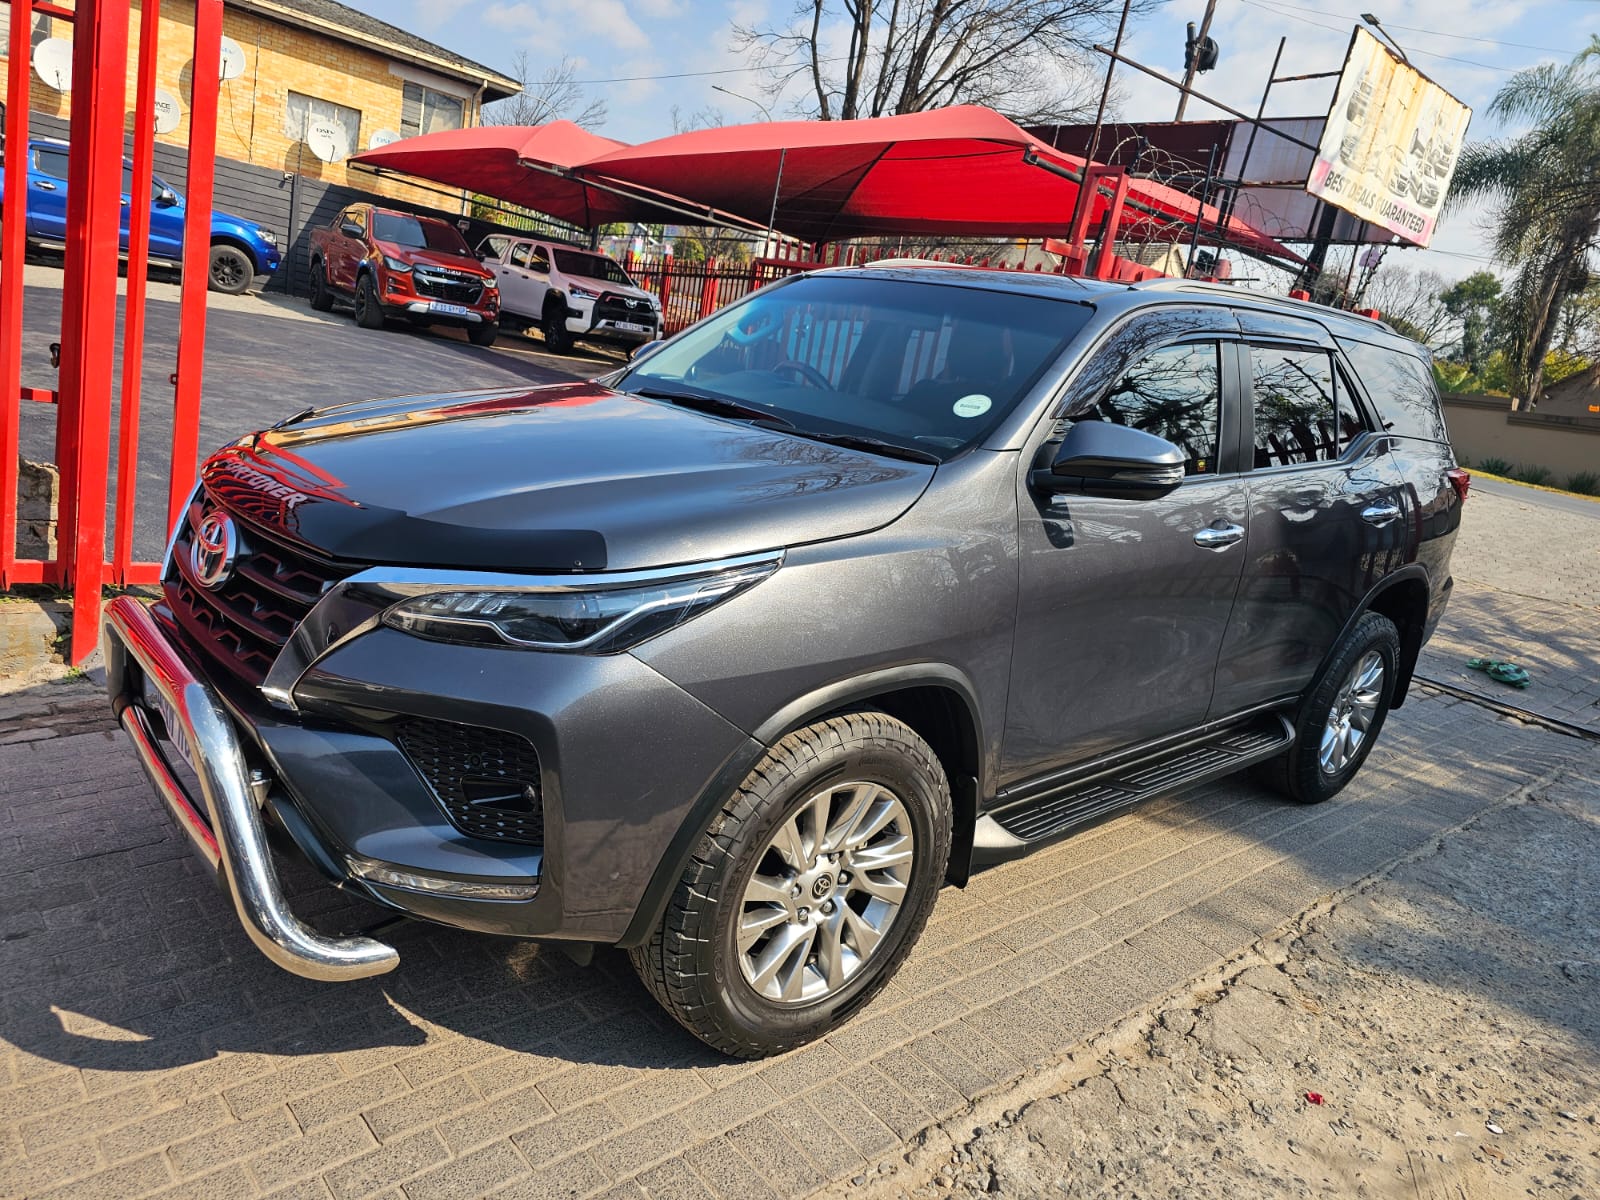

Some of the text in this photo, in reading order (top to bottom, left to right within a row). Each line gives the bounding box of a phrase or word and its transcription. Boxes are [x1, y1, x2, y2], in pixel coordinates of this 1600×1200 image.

[1325, 169, 1425, 234] BEST DEALS GUARANTEED
